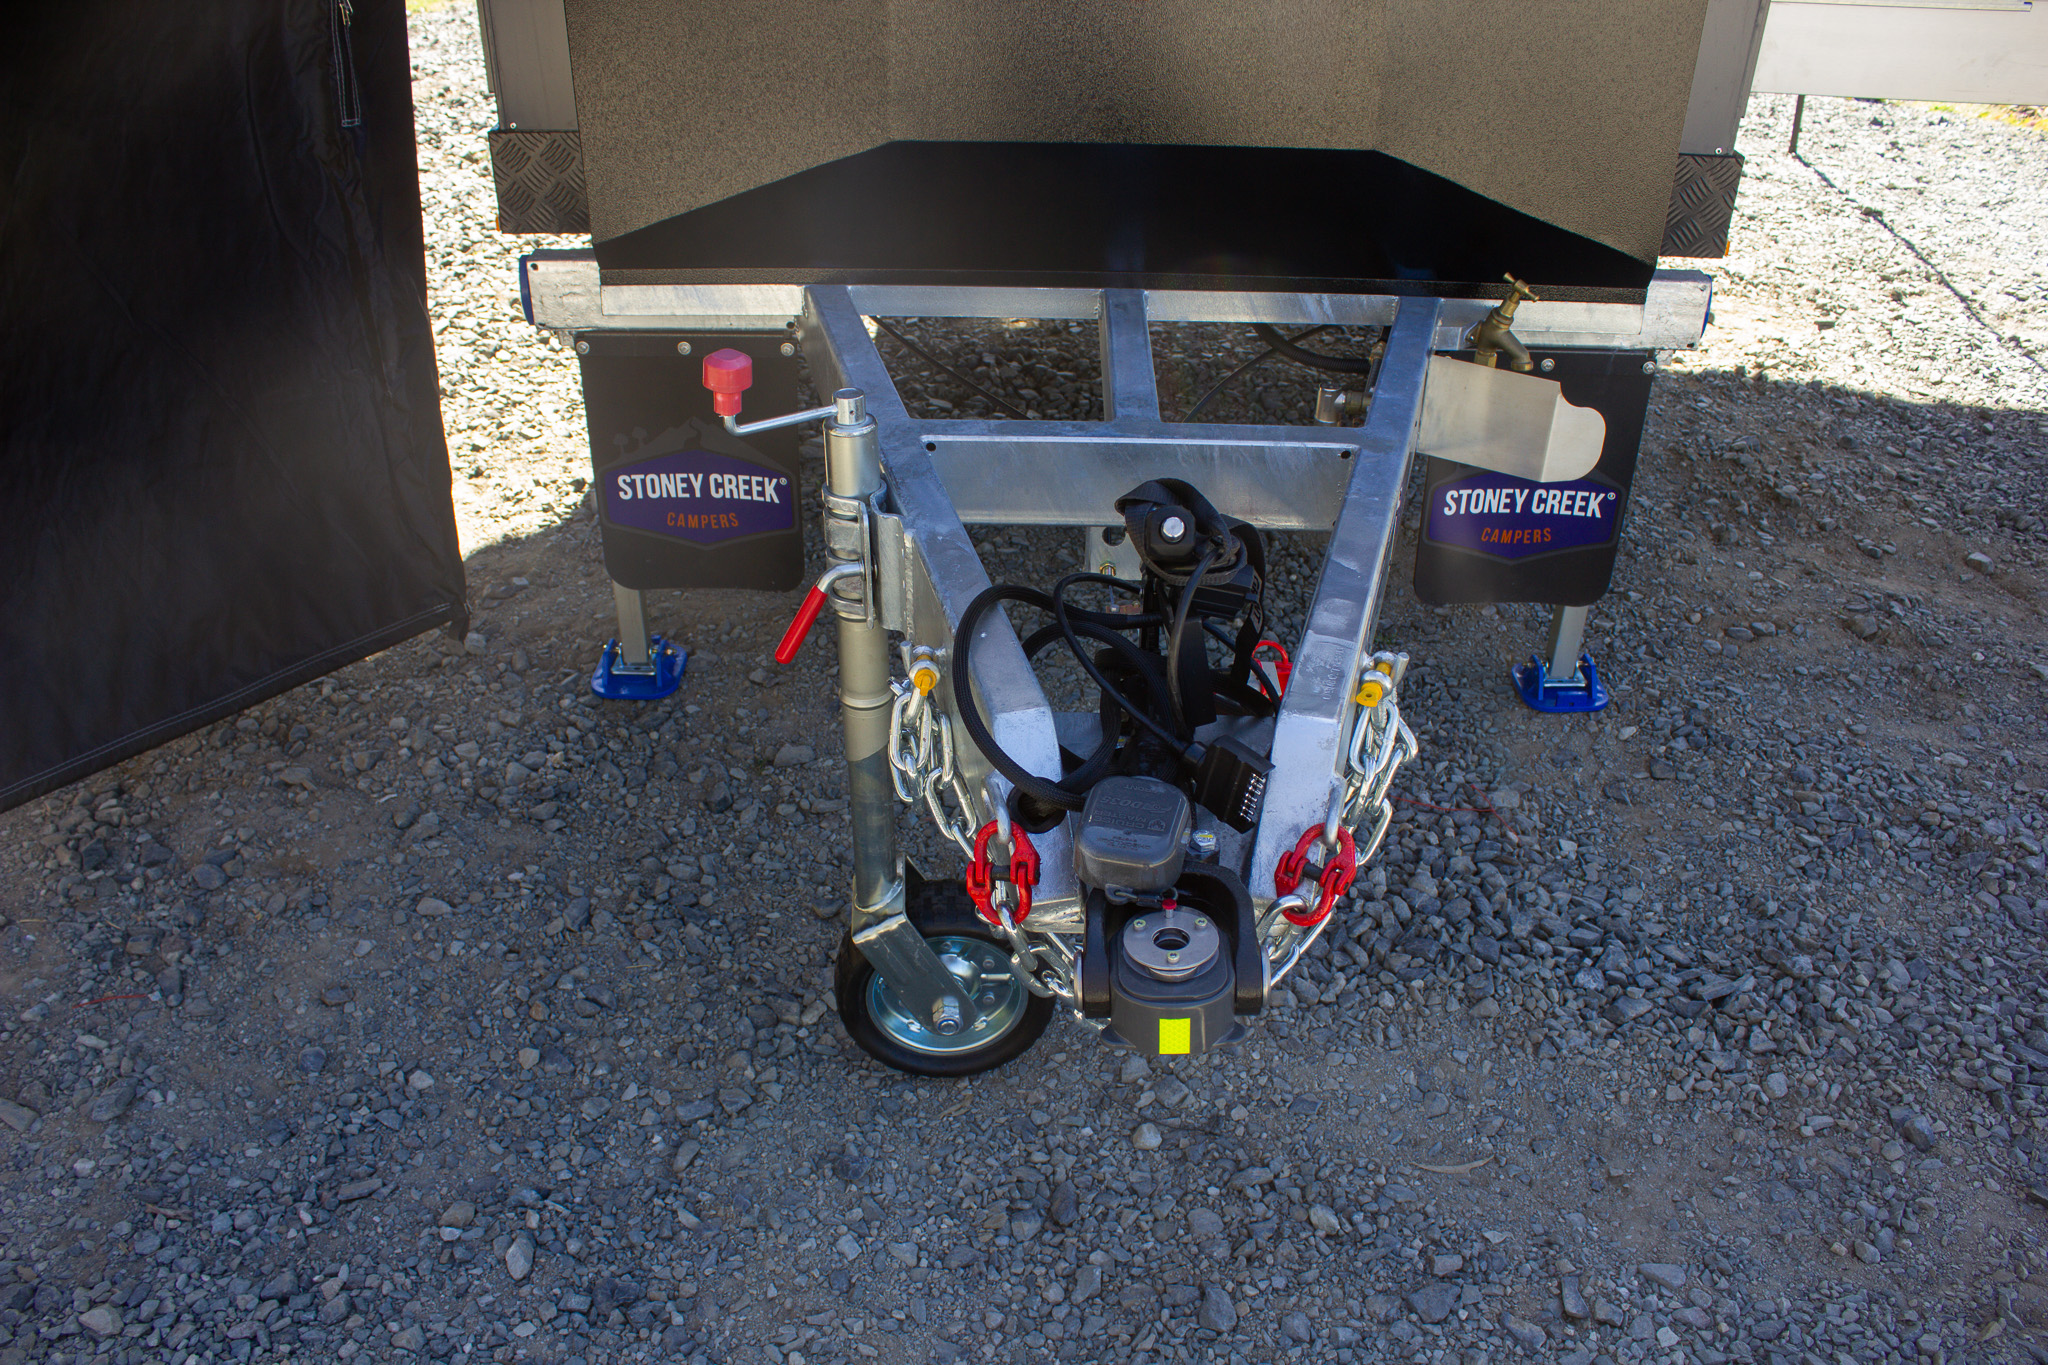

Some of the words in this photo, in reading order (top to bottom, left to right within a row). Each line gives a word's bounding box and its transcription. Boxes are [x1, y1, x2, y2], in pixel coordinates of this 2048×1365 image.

[617, 473, 703, 500] STONEY
[1443, 488, 1530, 516] STONEY
[667, 511, 739, 529] CAMPERS
[1481, 527, 1552, 545] CAMPERS
